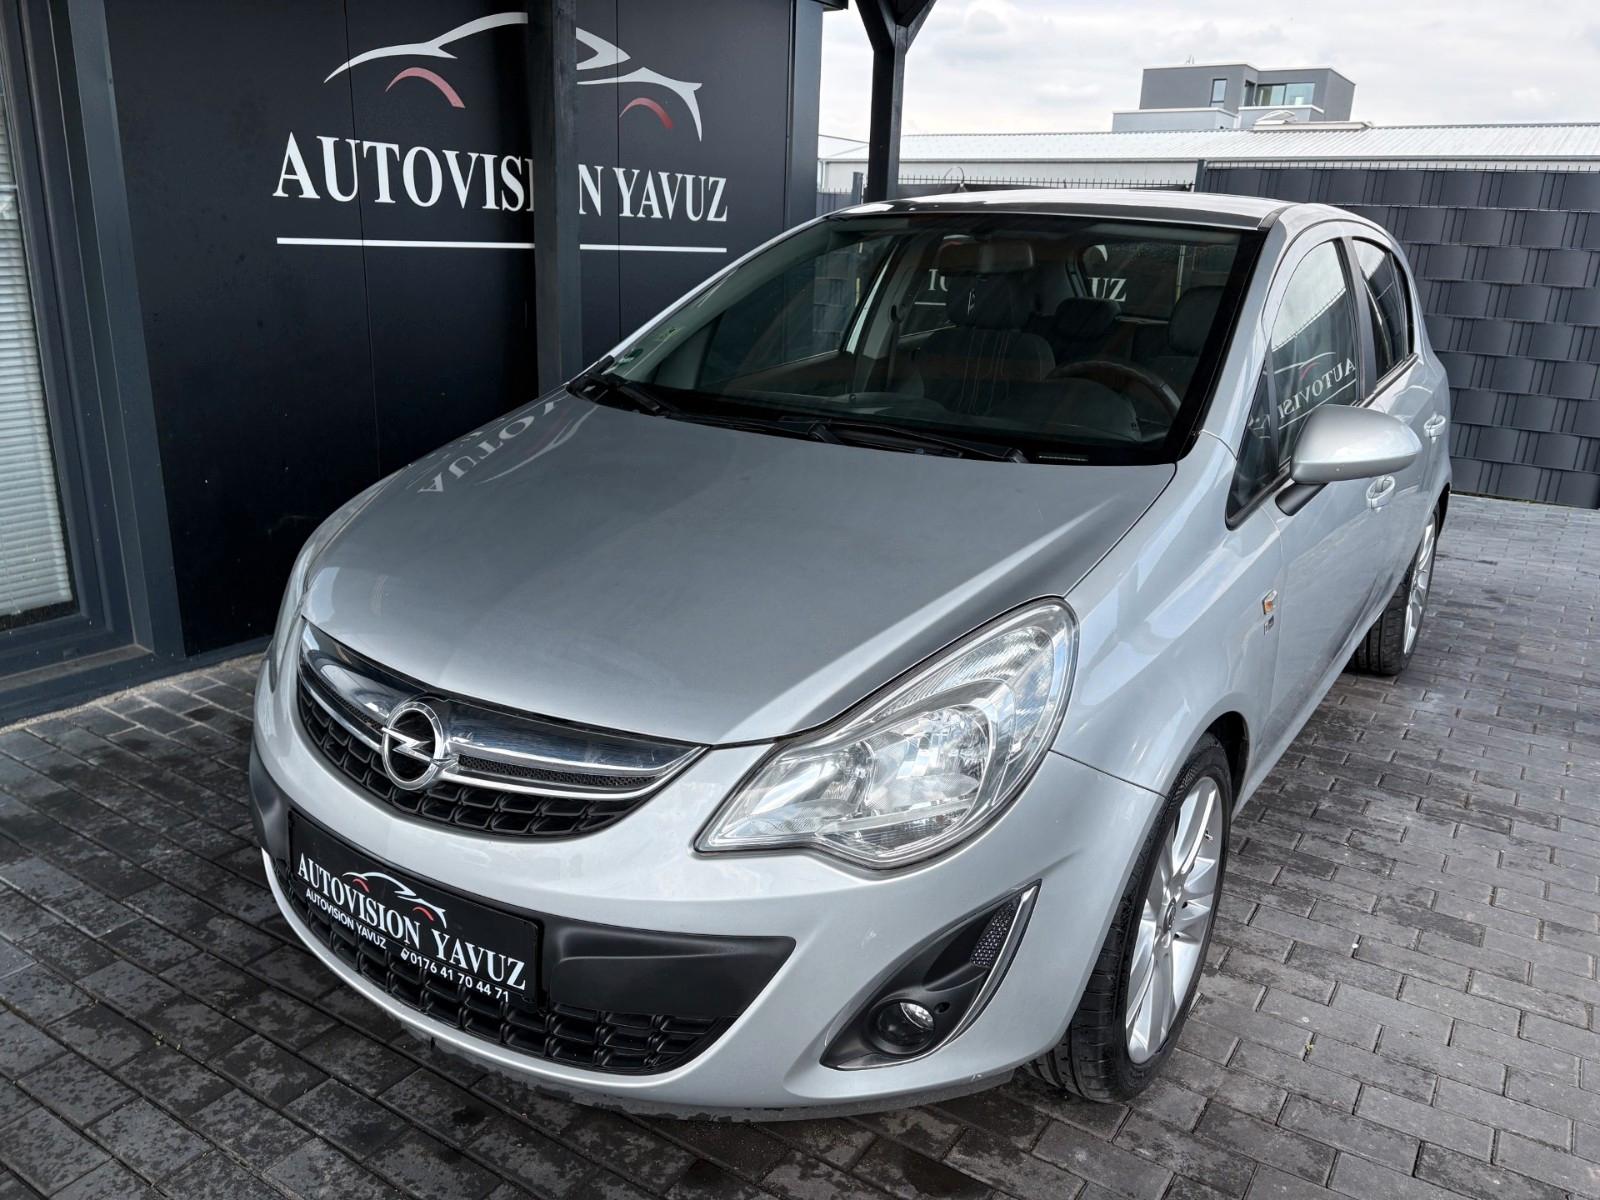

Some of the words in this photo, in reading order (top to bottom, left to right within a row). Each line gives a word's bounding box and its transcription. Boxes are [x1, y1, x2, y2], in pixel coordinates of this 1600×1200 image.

[612, 166, 728, 223] YAVUZ
[297, 852, 421, 950] AUTOVISION
[431, 928, 527, 991] YAVUZ
[305, 887, 355, 930] AUTOVISION
[355, 921, 387, 950] YAVUZ
[410, 952, 438, 974] 0176
[440, 966, 453, 981] 41
[457, 972, 473, 989] 70
[475, 980, 492, 996] 44
[494, 986, 509, 1003] 71
